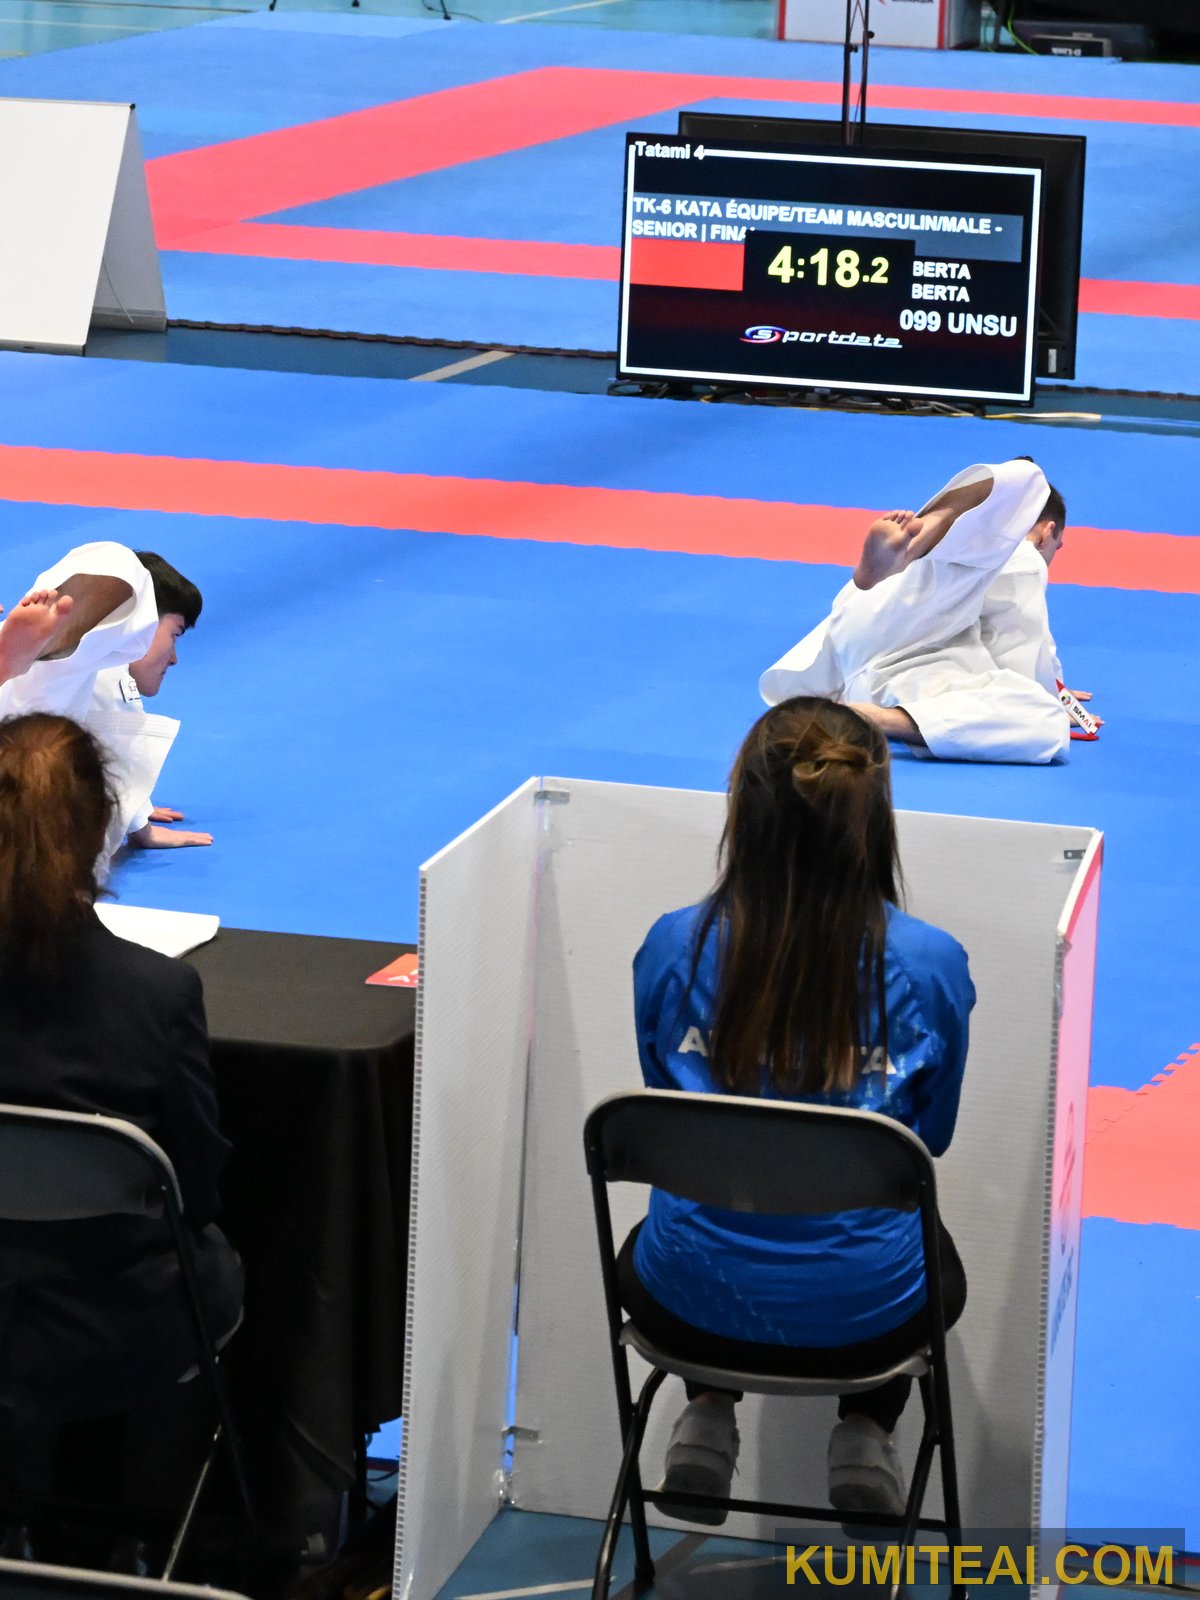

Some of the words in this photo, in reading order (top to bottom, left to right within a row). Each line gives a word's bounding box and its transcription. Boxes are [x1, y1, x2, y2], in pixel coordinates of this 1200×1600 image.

[634, 140, 691, 159] Tatami
[693, 144, 705, 160] 4
[632, 197, 672, 215] TK-6
[675, 199, 723, 218] KATA
[725, 198, 843, 226] ÉQUIPE/TEAM
[846, 210, 993, 235] MASCULIN/MALE
[631, 218, 698, 239] SENIOR
[767, 245, 890, 288] 4:18.2
[912, 260, 972, 280] BERTA
[911, 283, 971, 303] BERTA
[899, 308, 942, 332] 099
[947, 312, 1018, 337] UNSU
